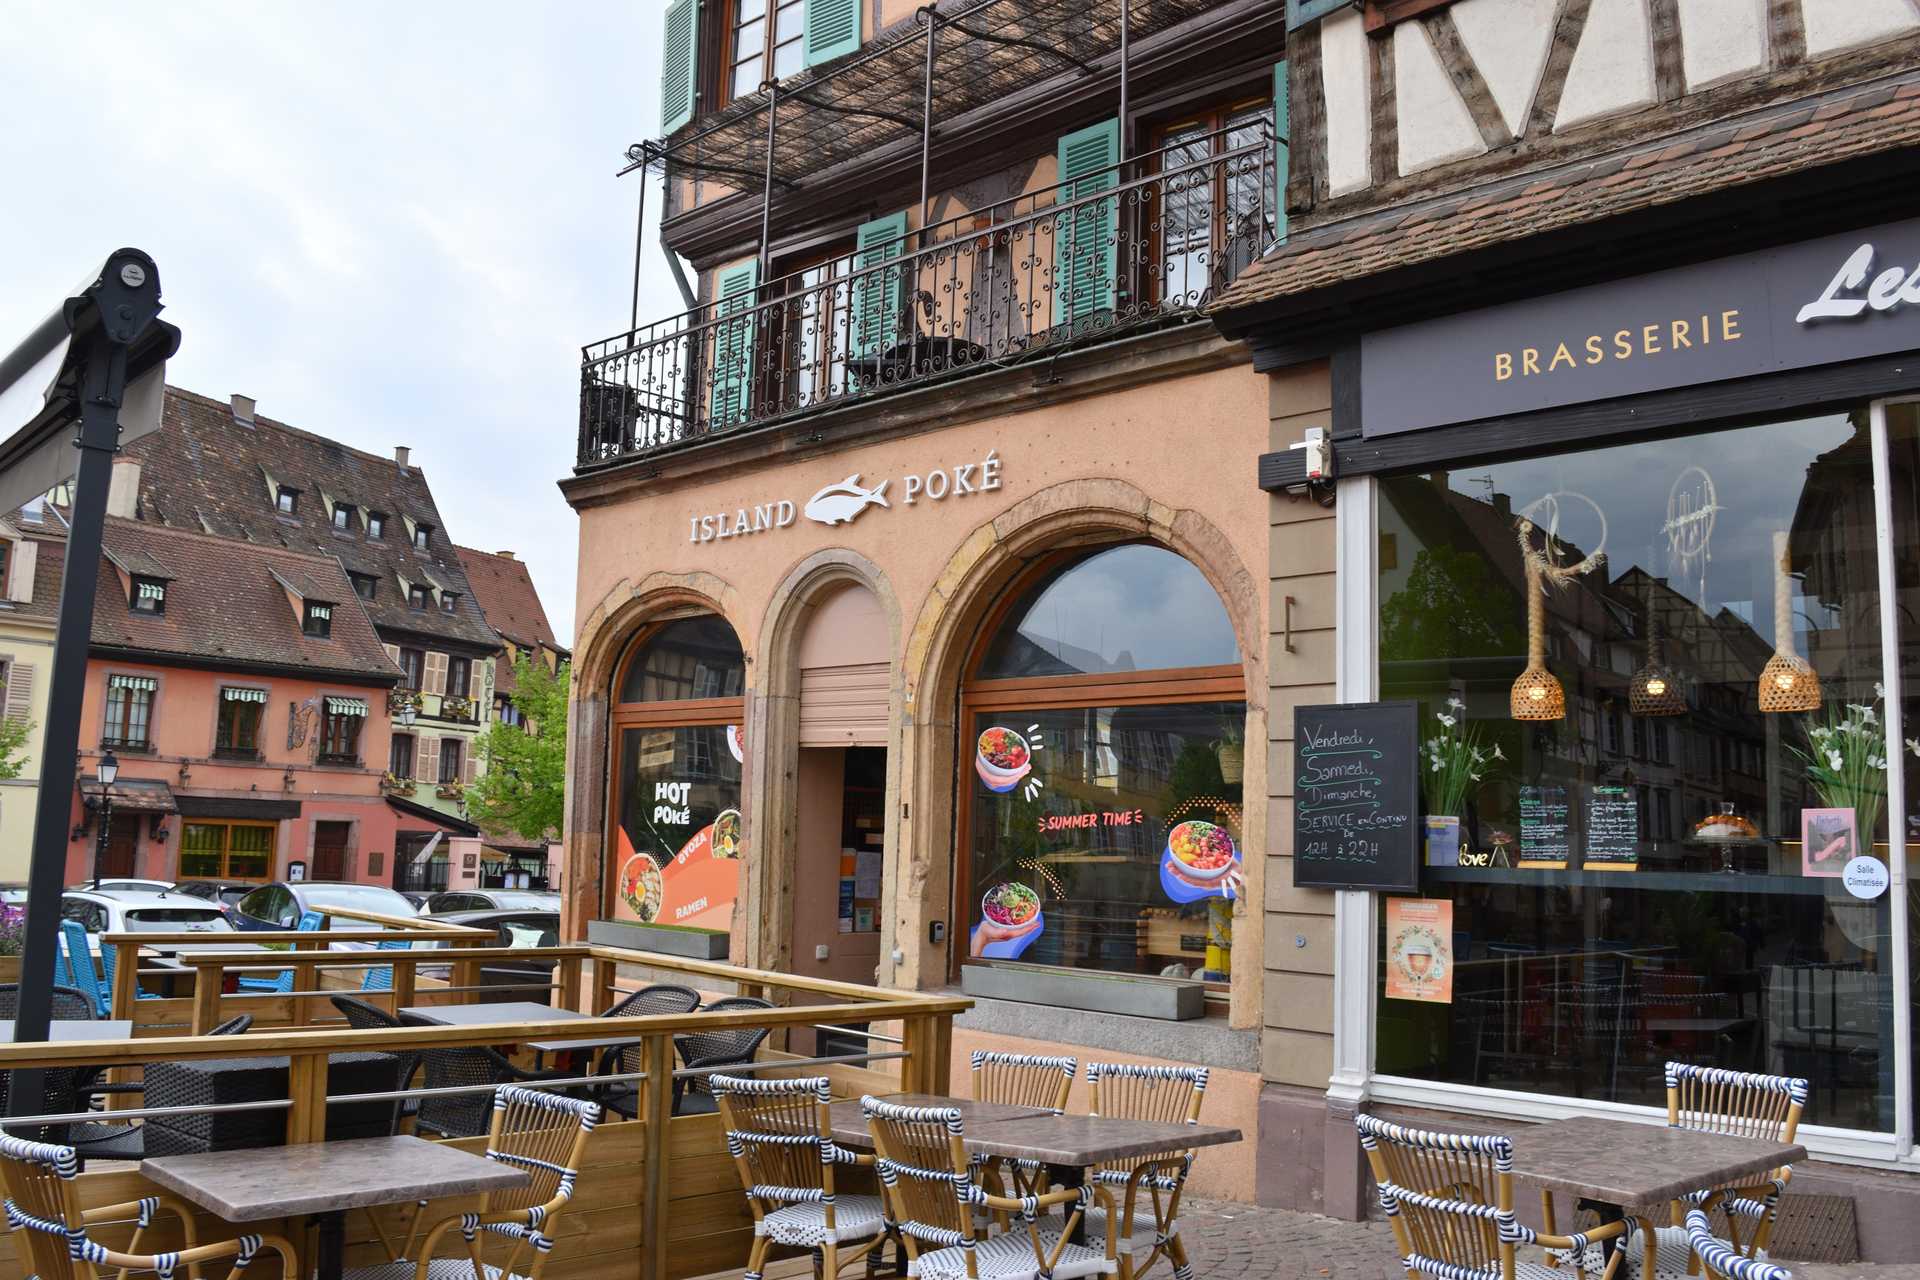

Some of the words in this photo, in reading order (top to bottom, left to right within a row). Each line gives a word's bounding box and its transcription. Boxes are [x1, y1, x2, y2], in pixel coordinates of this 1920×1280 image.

[1495, 310, 1742, 381] BRASSERIE
[690, 500, 796, 542] ISLAND
[903, 449, 1002, 504] POKÉ
[655, 782, 691, 806] HOT
[1047, 813, 1098, 830] SUMMER
[1102, 811, 1133, 826] TIME
[1299, 811, 1355, 830] SERVICE
[677, 832, 707, 864] GYOZA
[1304, 841, 1328, 855] 12H
[1349, 840, 1379, 857] 22H
[1458, 843, 1488, 866] love
[1856, 864, 1874, 874] Salle
[1847, 877, 1884, 887] Climatisée
[675, 897, 708, 919] RAMEN
